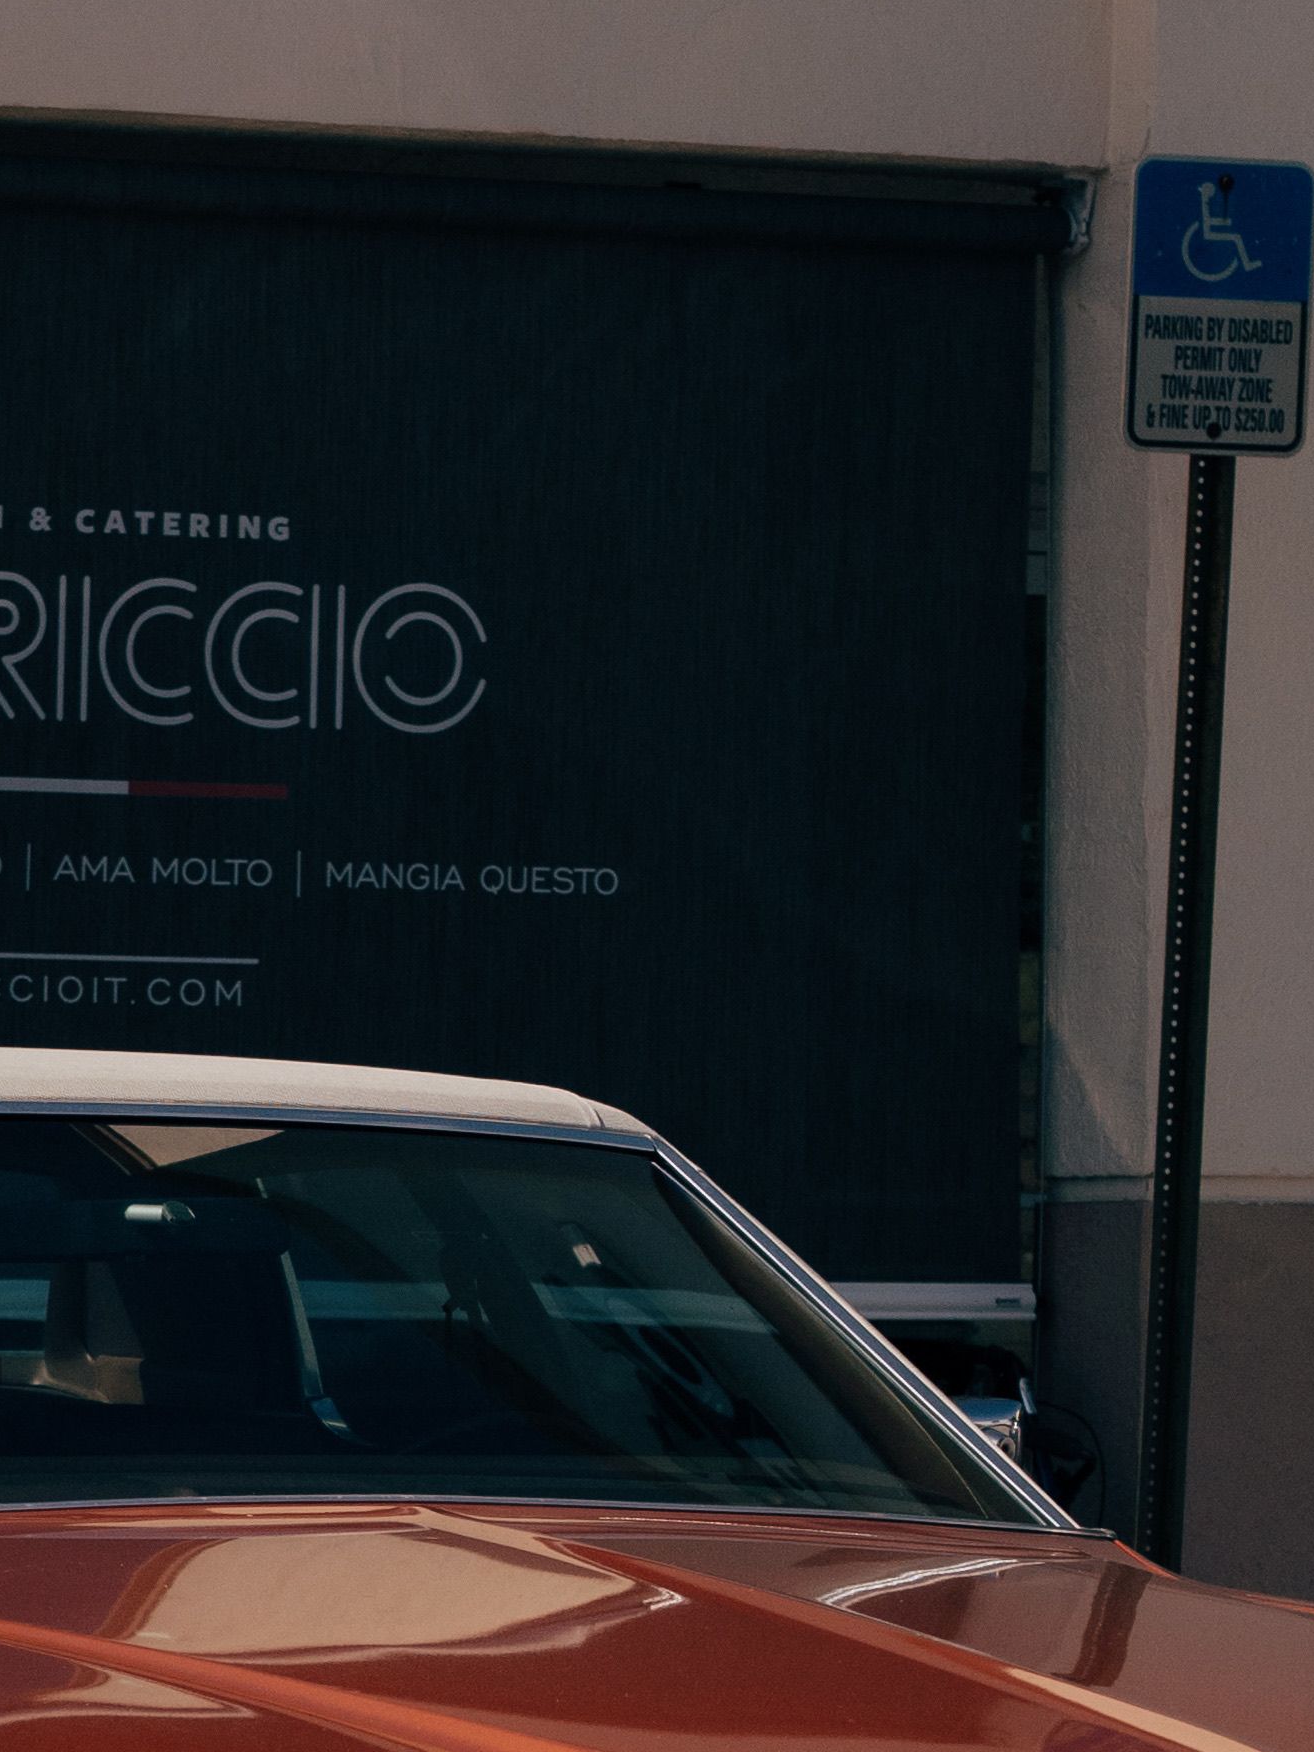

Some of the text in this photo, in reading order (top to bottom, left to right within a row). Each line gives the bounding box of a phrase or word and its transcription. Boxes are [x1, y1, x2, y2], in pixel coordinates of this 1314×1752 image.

[1145, 314, 1293, 345] PARKING BY DISABLED
[1174, 345, 1263, 373] PERMIT ONLY
[1161, 374, 1273, 403] TOW-AWAY ZONE
[1146, 404, 1284, 433] & FINE UP TO $250.00
[29, 505, 53, 532] &
[75, 508, 292, 541] CATERING
[53, 854, 137, 884] AMA
[150, 855, 273, 888] MOLTO
[325, 860, 465, 892] MANGIA
[480, 863, 620, 897] QUESTO
